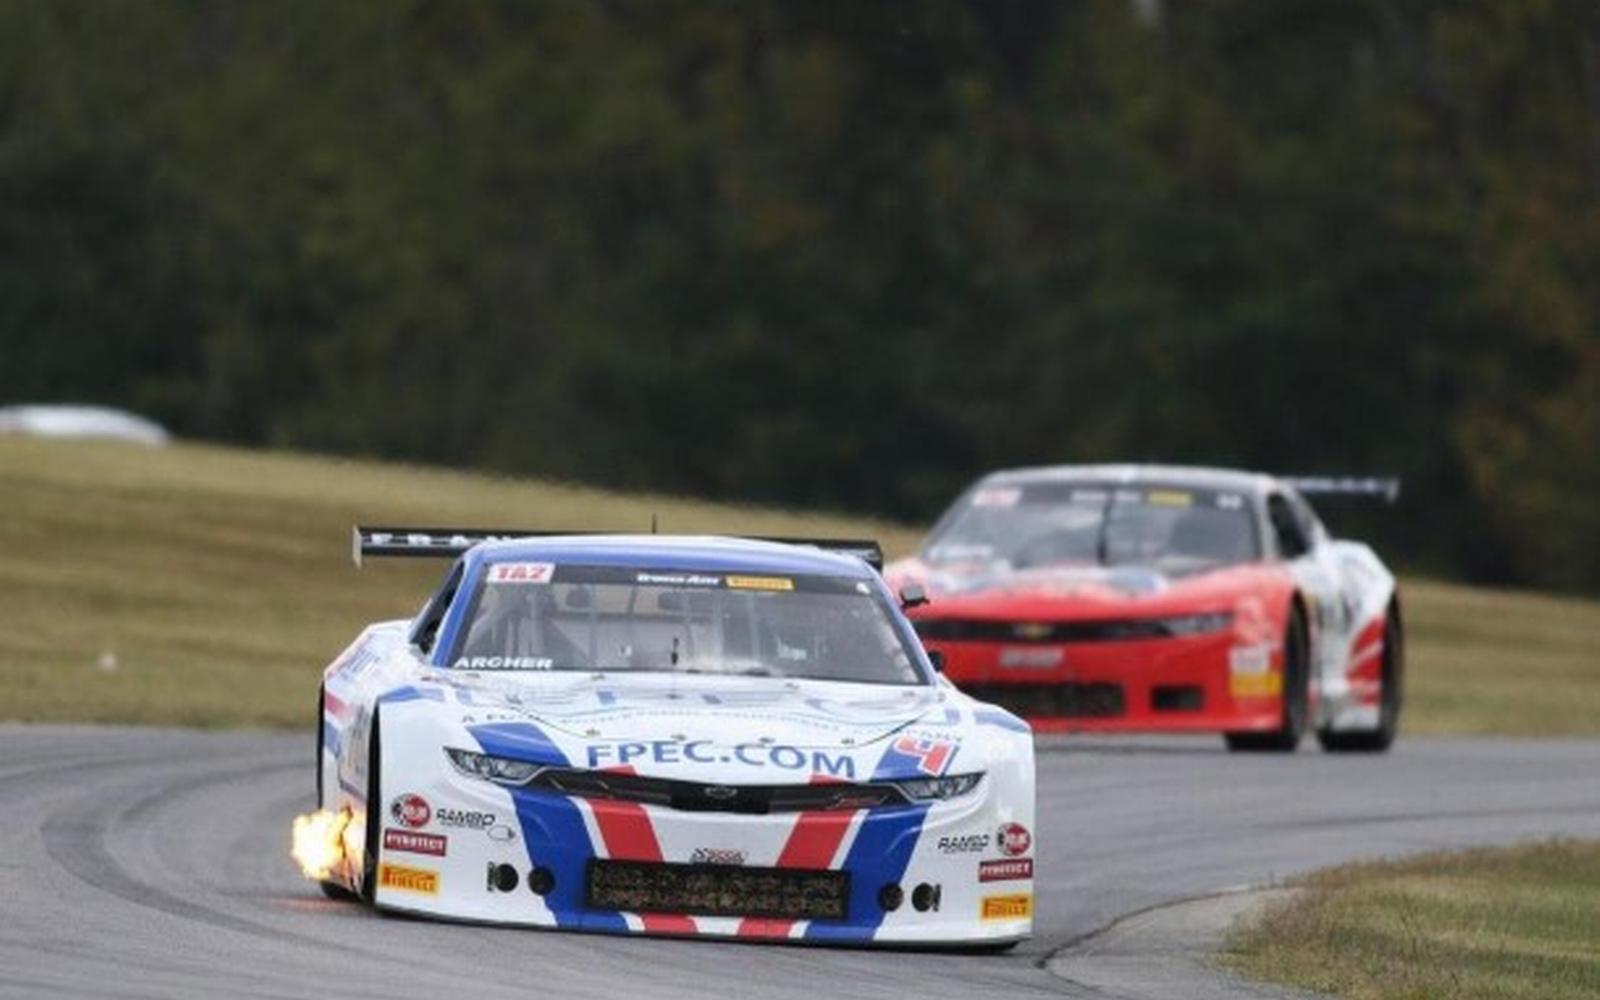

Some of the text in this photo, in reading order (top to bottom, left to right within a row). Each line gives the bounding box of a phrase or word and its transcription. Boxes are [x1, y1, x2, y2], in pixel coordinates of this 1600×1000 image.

[453, 656, 553, 669] ARCHER
[586, 738, 856, 778] FPEC.COM
[893, 736, 953, 777] 4
